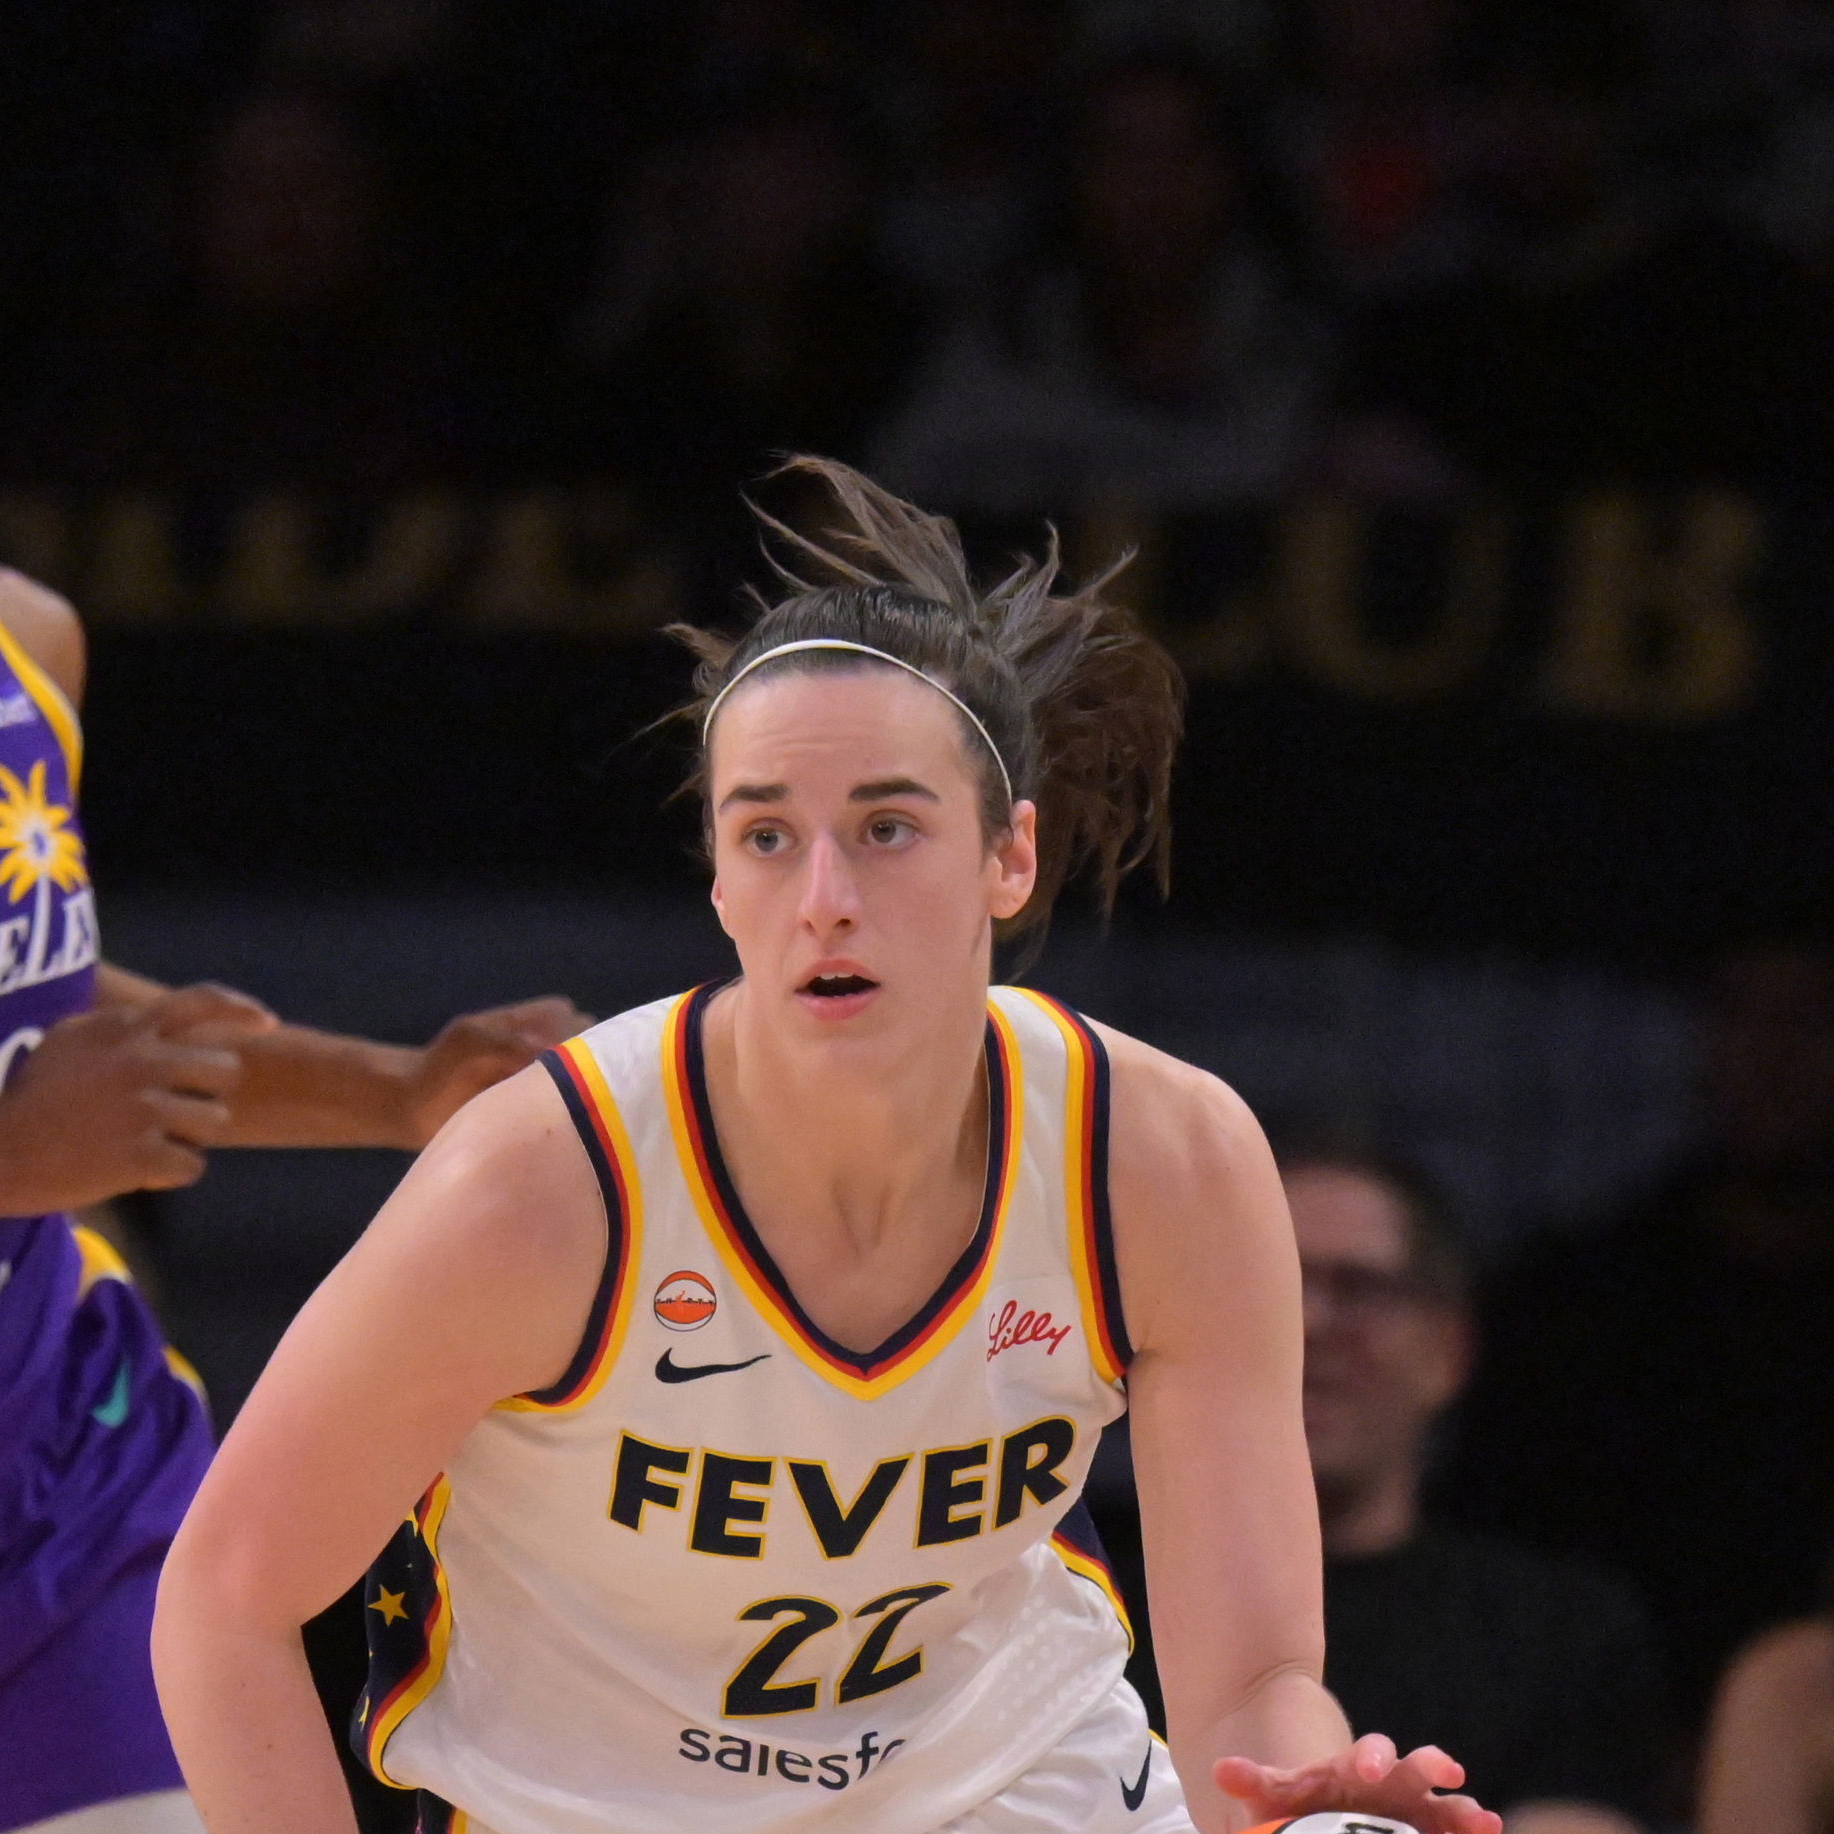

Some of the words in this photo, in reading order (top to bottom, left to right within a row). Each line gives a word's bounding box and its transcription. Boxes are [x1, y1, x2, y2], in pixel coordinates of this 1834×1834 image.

[986, 1299, 1072, 1363] Lilly
[607, 1414, 1077, 1562] FEVER
[720, 1580, 954, 1720] 22
